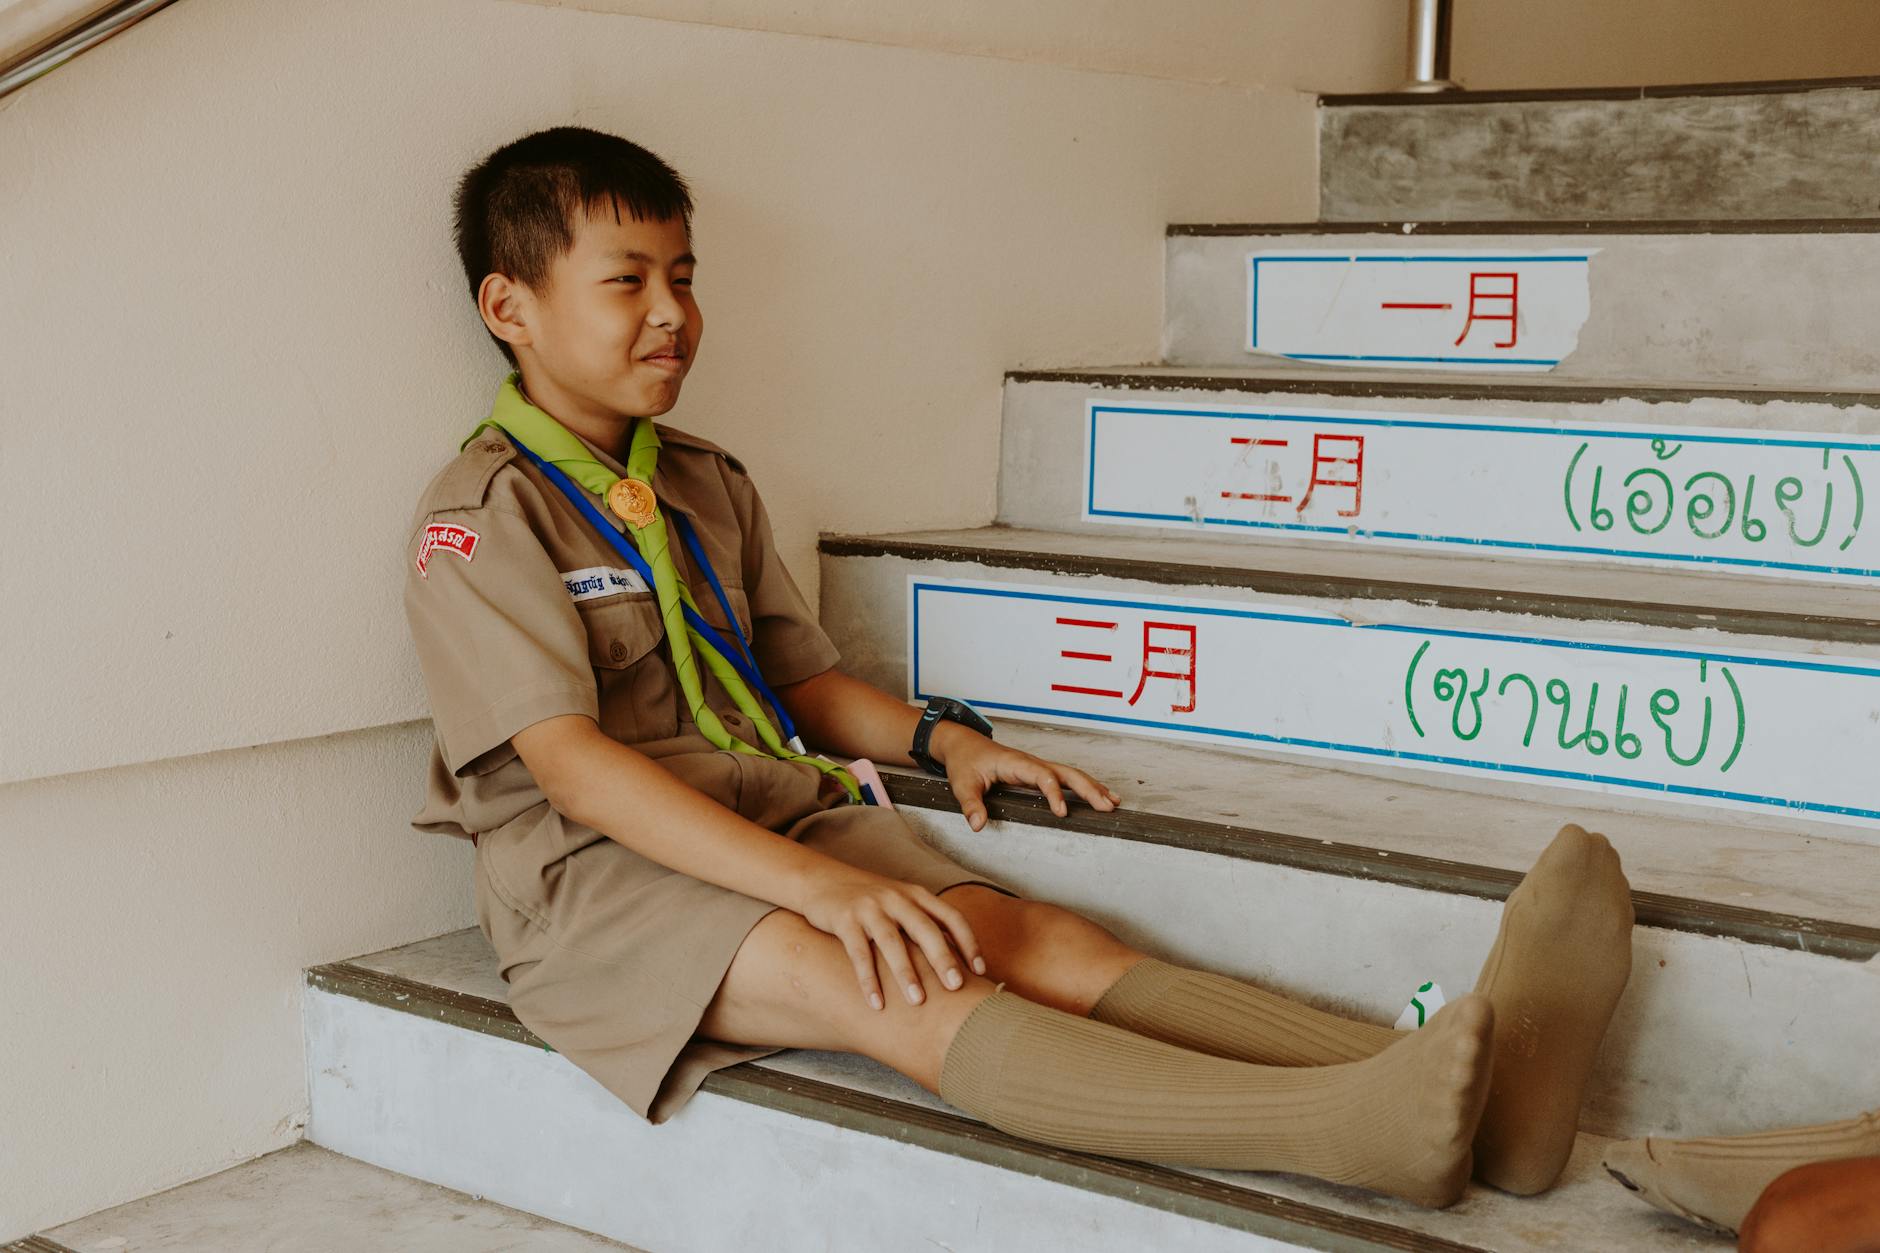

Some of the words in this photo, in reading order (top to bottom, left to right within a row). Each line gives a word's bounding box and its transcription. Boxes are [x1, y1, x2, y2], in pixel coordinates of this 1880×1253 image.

[1382, 272, 1519, 348] 一月
[1221, 433, 1365, 517] 二月
[1051, 617, 1197, 713] 三月
[1404, 640, 1746, 772] (ซานเย่)
